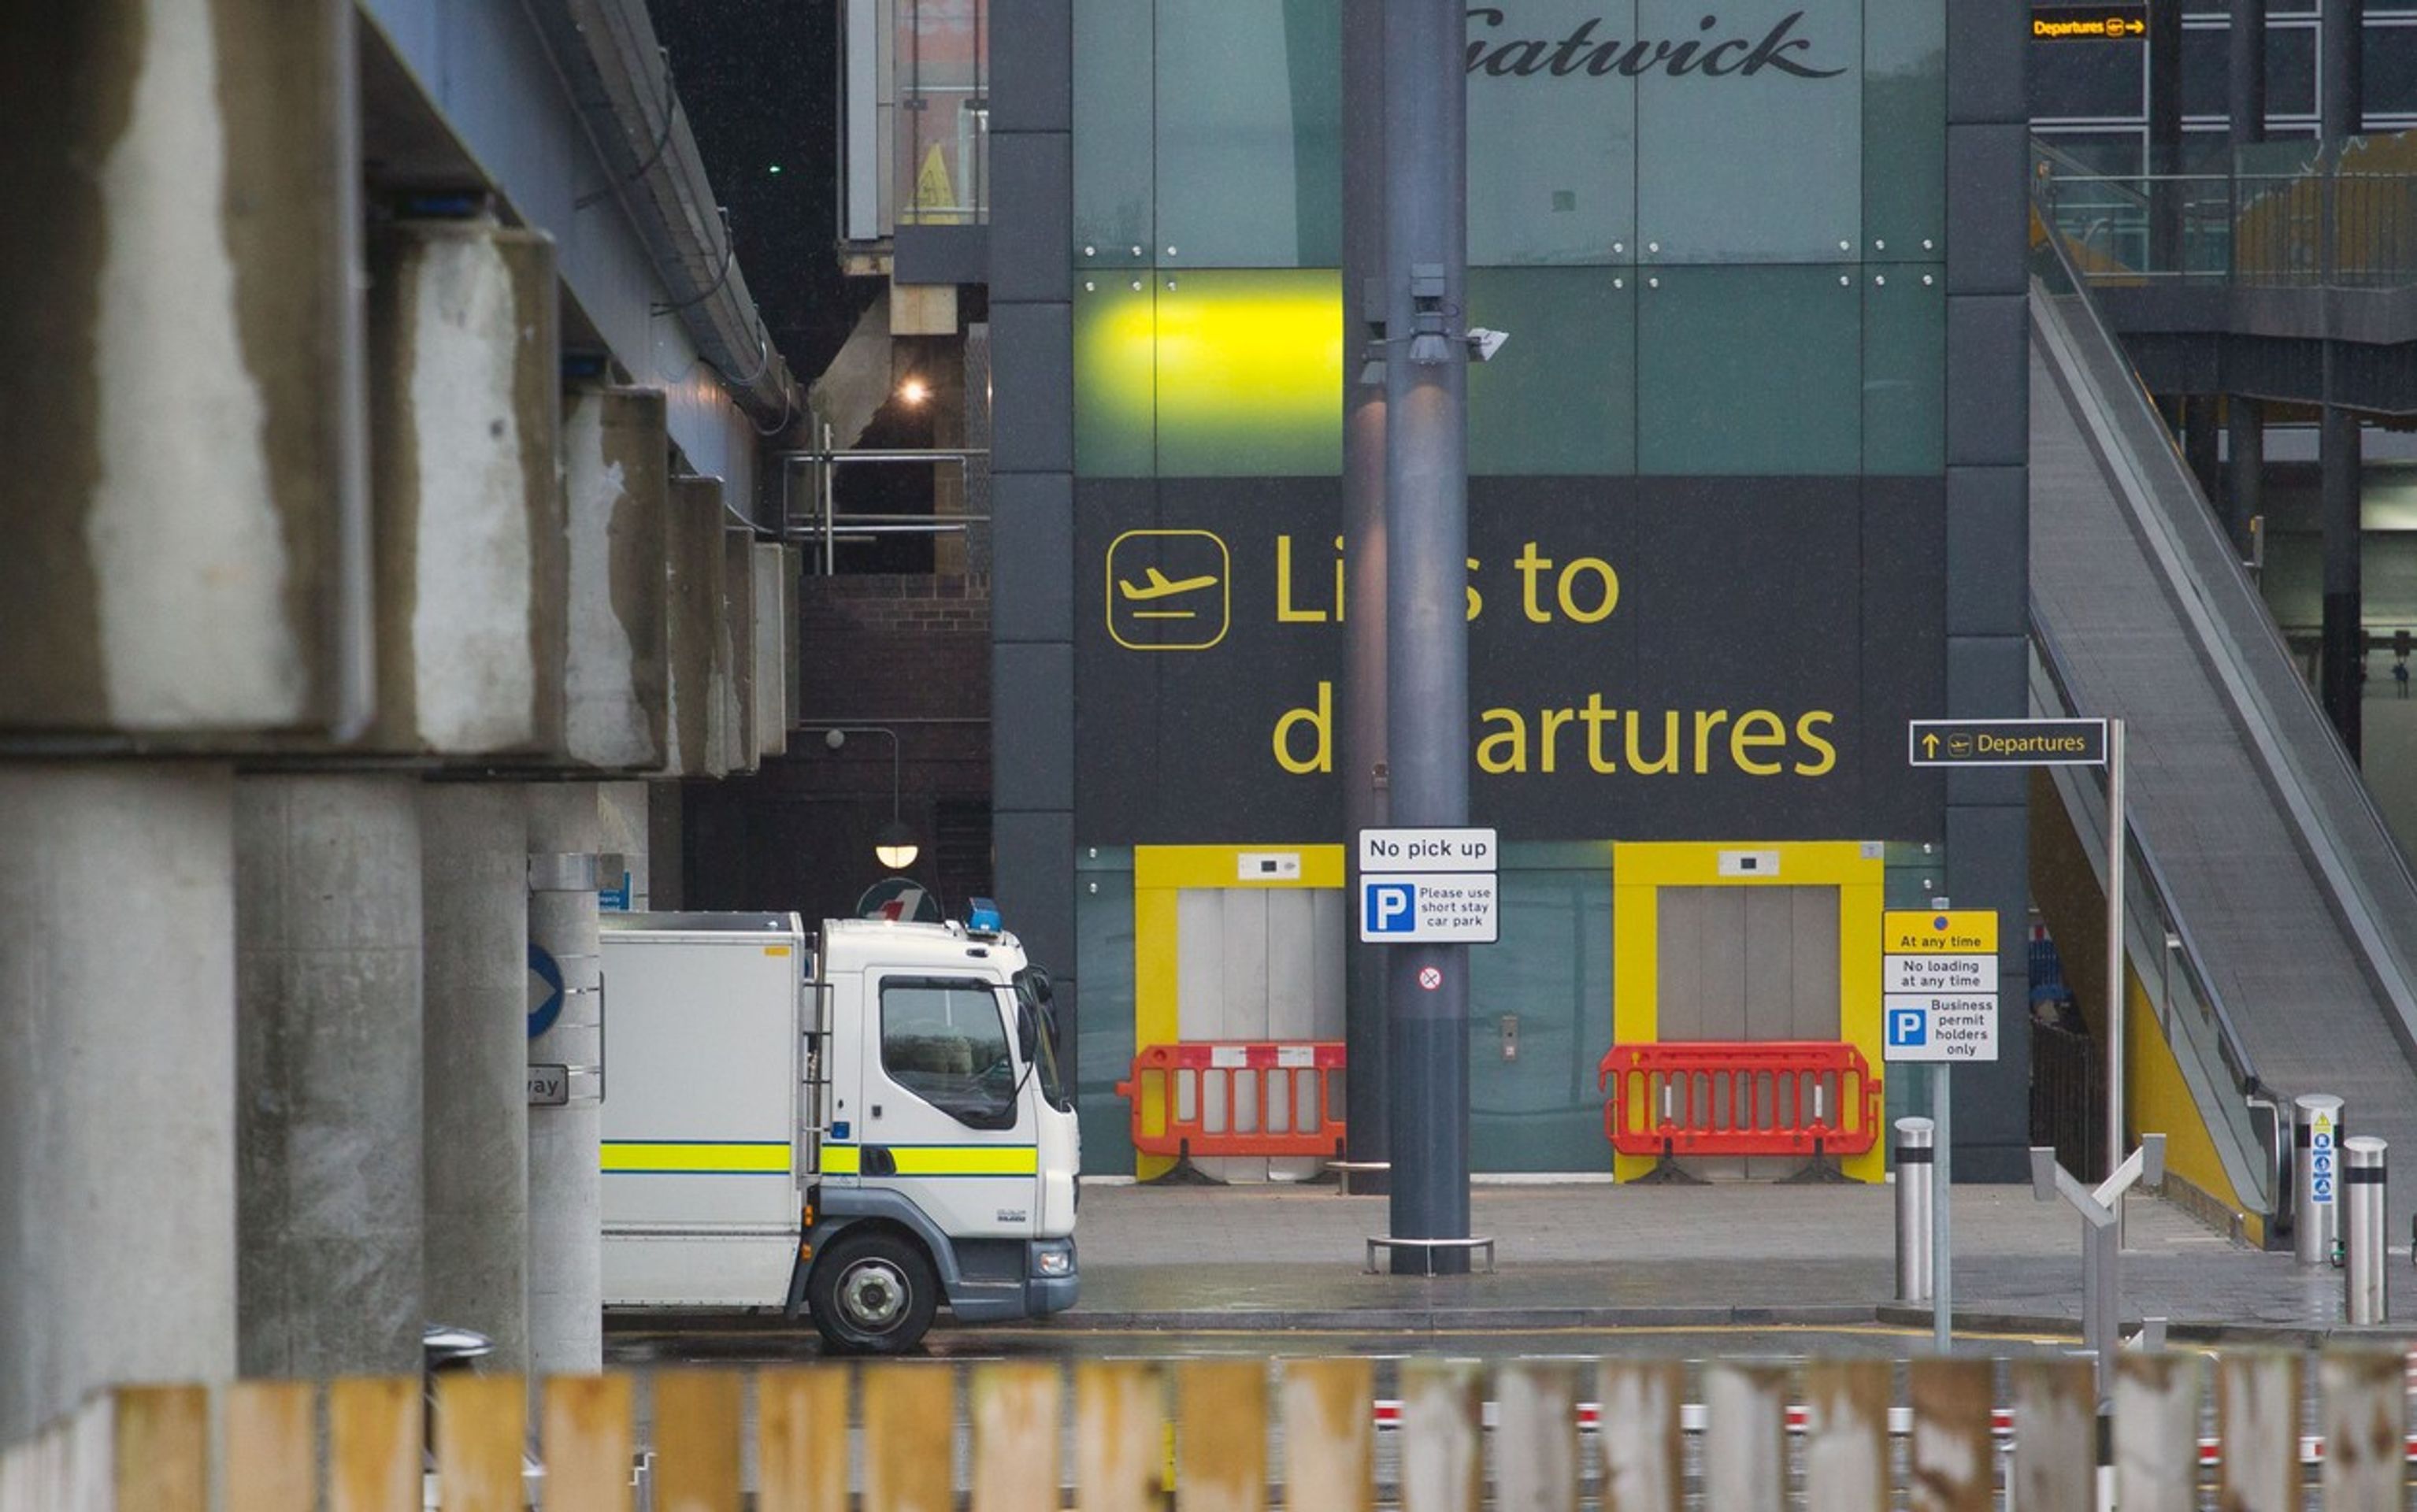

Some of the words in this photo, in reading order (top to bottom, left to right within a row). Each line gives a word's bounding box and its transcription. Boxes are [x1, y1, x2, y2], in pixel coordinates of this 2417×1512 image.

[2033, 20, 2104, 36] Departures
[1514, 542, 1620, 624] to
[1272, 681, 1837, 776] dartures
[1978, 734, 2085, 754] Departures
[1370, 839, 1399, 856] No
[1408, 839, 1451, 859] pick
[1461, 843, 1487, 858] up
[1420, 888, 1463, 899] Please
[1468, 890, 1491, 899] use
[1377, 888, 1407, 929] P
[1421, 902, 1456, 913] short
[1461, 903, 1489, 914] stay
[1427, 917, 1448, 927] car
[1453, 916, 1483, 928] park
[1900, 936, 1916, 947] At
[1922, 938, 1946, 949] any
[1951, 936, 1981, 947] time
[1903, 961, 1923, 972] No
[1928, 960, 1979, 973] loading
[1901, 976, 1915, 987] at
[1920, 978, 1944, 988] any
[1949, 976, 1981, 987] time
[1931, 999, 1993, 1010] Business
[1939, 1014, 1985, 1026] permit
[1898, 1014, 1921, 1043] P
[1935, 1029, 1988, 1040] holders
[1947, 1044, 1977, 1056] only
[528, 1080, 558, 1097] ay
